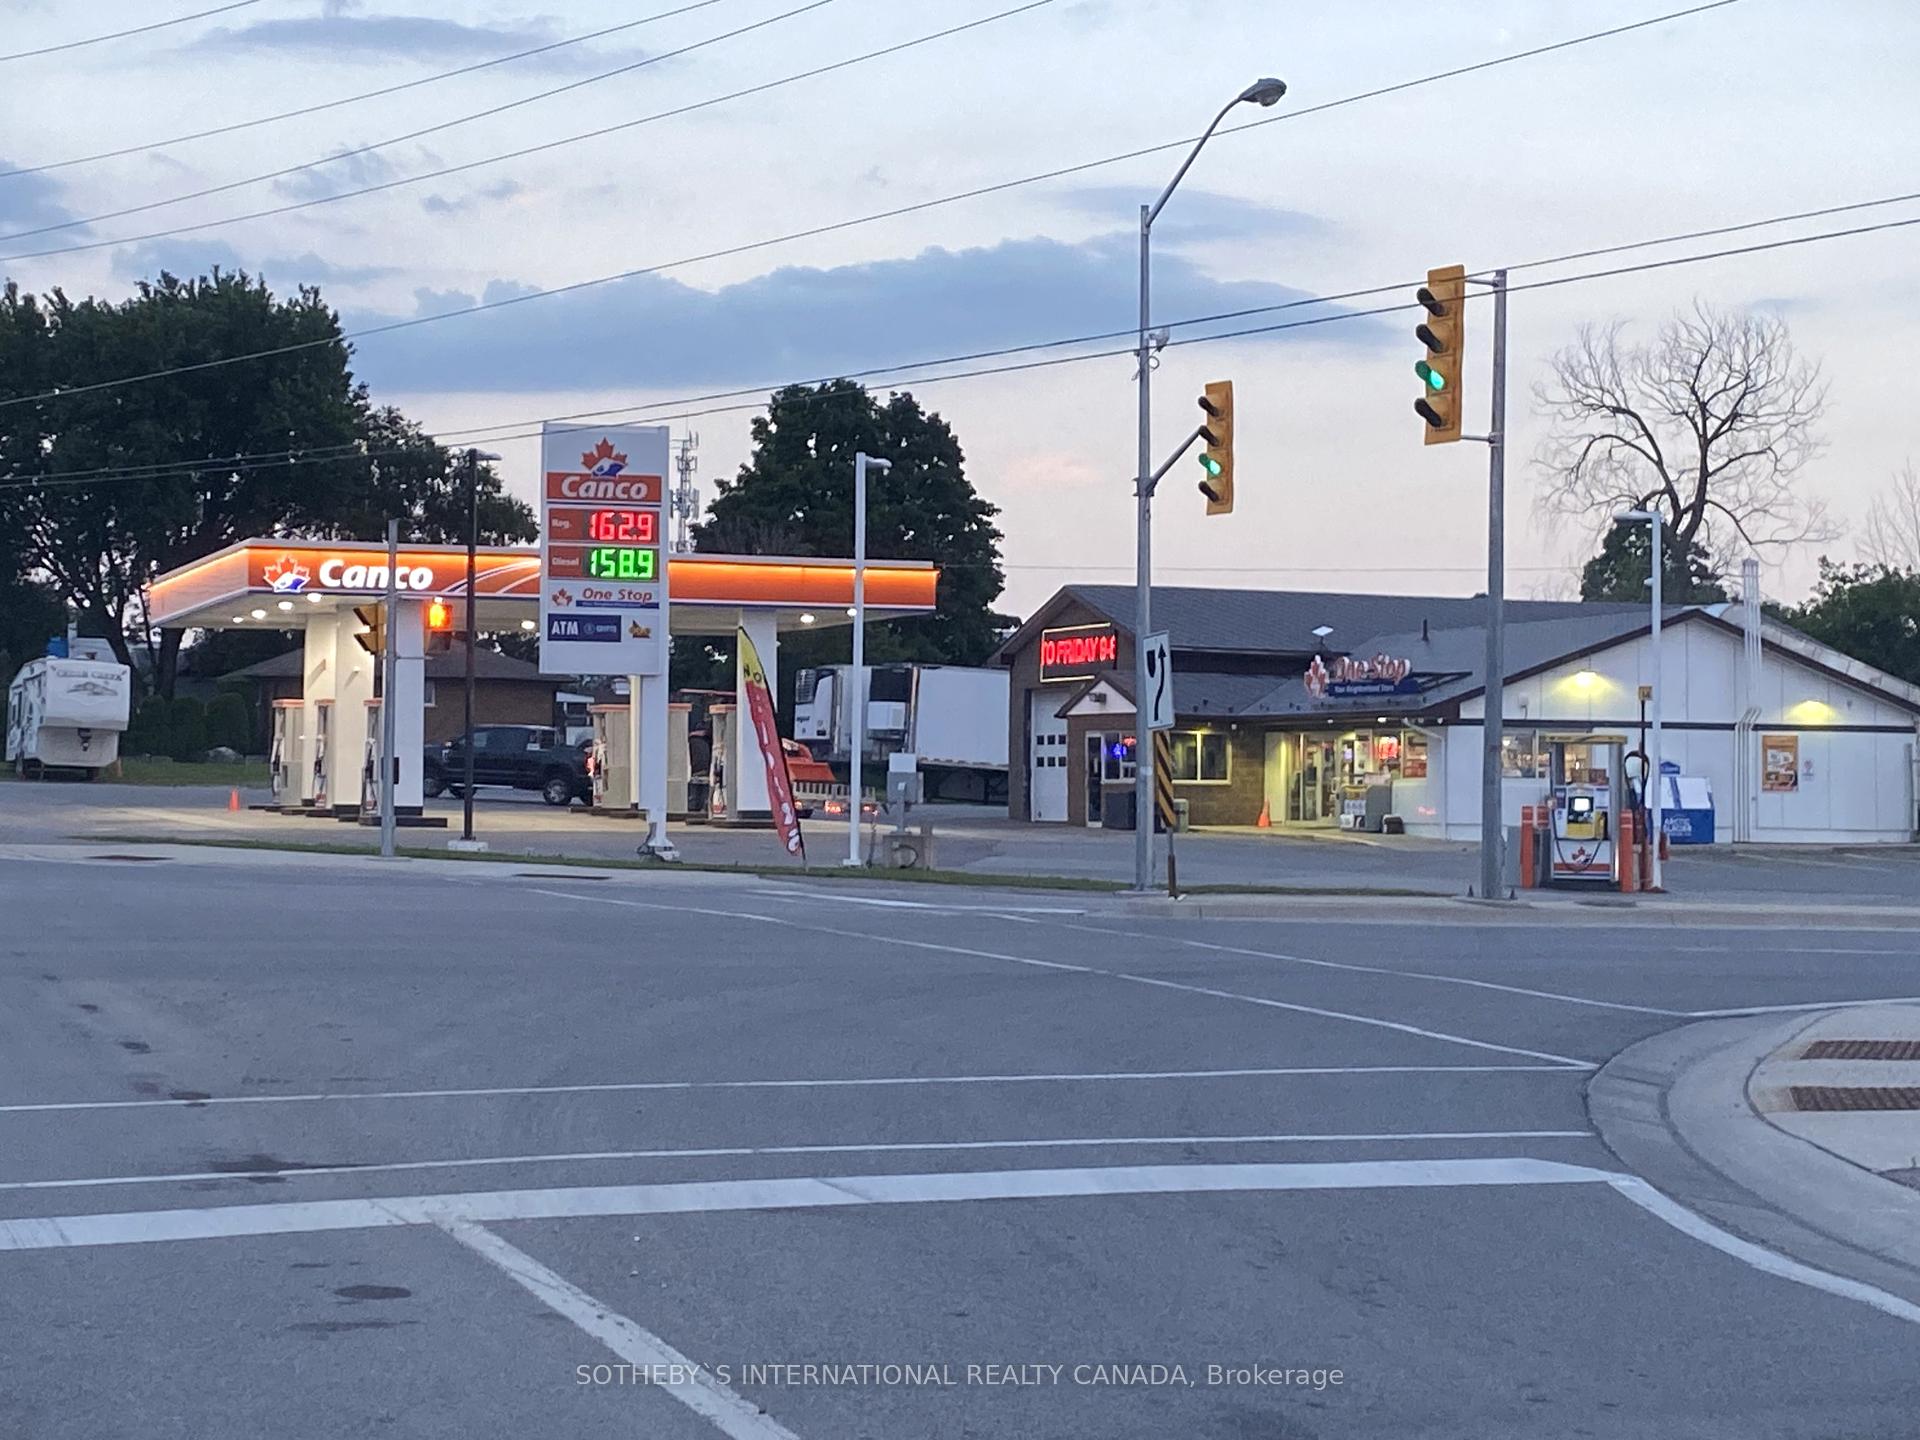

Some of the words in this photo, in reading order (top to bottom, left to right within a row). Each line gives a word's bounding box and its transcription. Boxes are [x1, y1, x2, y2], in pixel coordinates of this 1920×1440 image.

[562, 476, 648, 499] Canco
[319, 559, 433, 590] Canco
[583, 588, 612, 600] One
[618, 588, 652, 604] Stop
[552, 621, 579, 635] ATM
[1056, 636, 1098, 664] FRIDAY
[1369, 655, 1411, 686] Stop
